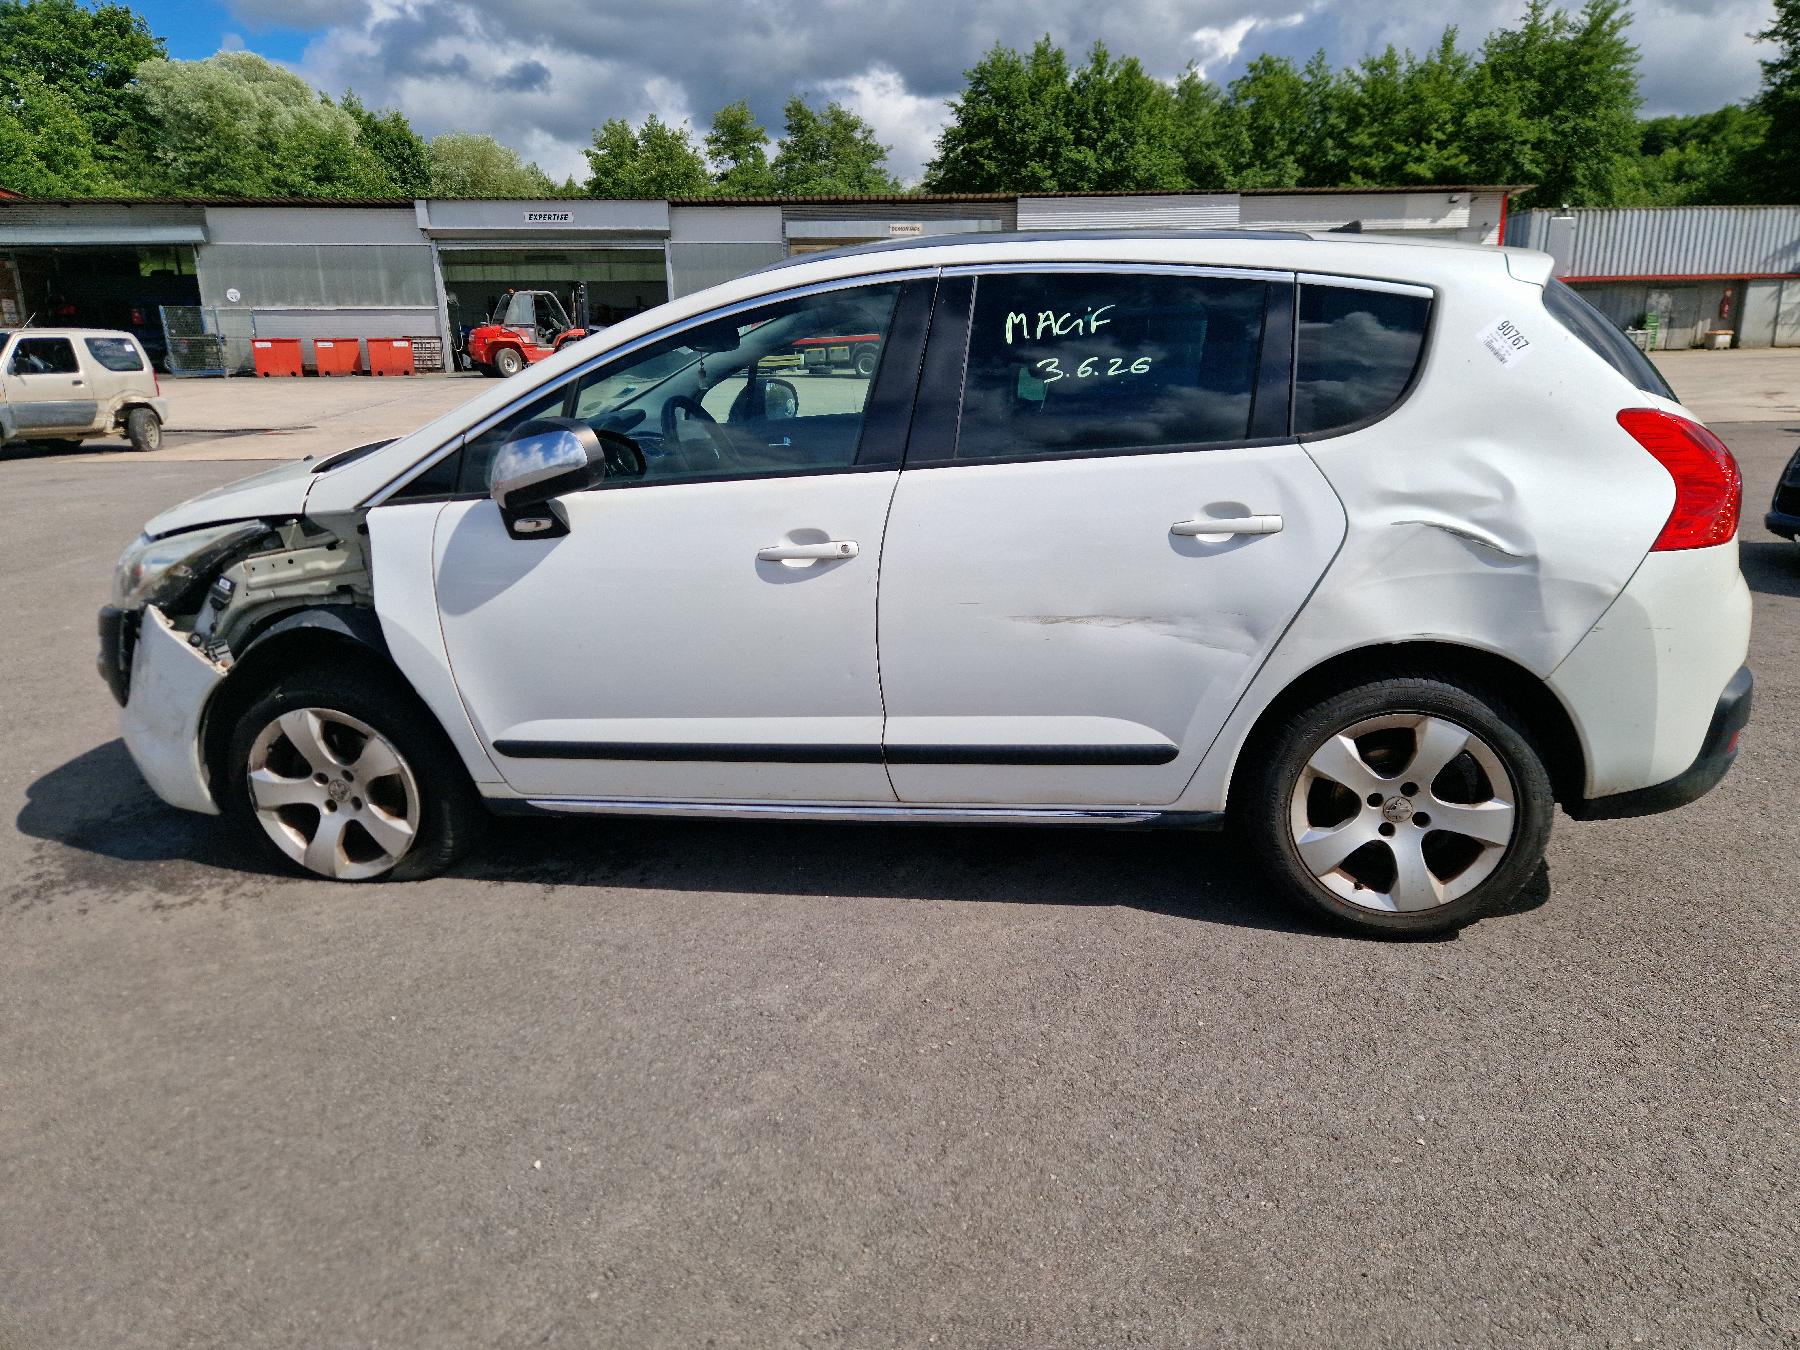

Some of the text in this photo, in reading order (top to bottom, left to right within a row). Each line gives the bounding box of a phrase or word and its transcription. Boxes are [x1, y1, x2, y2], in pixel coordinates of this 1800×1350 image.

[528, 213, 569, 221] EXPERTISE
[1497, 320, 1530, 350] 90767
[1036, 356, 1152, 384] 3.6.26
